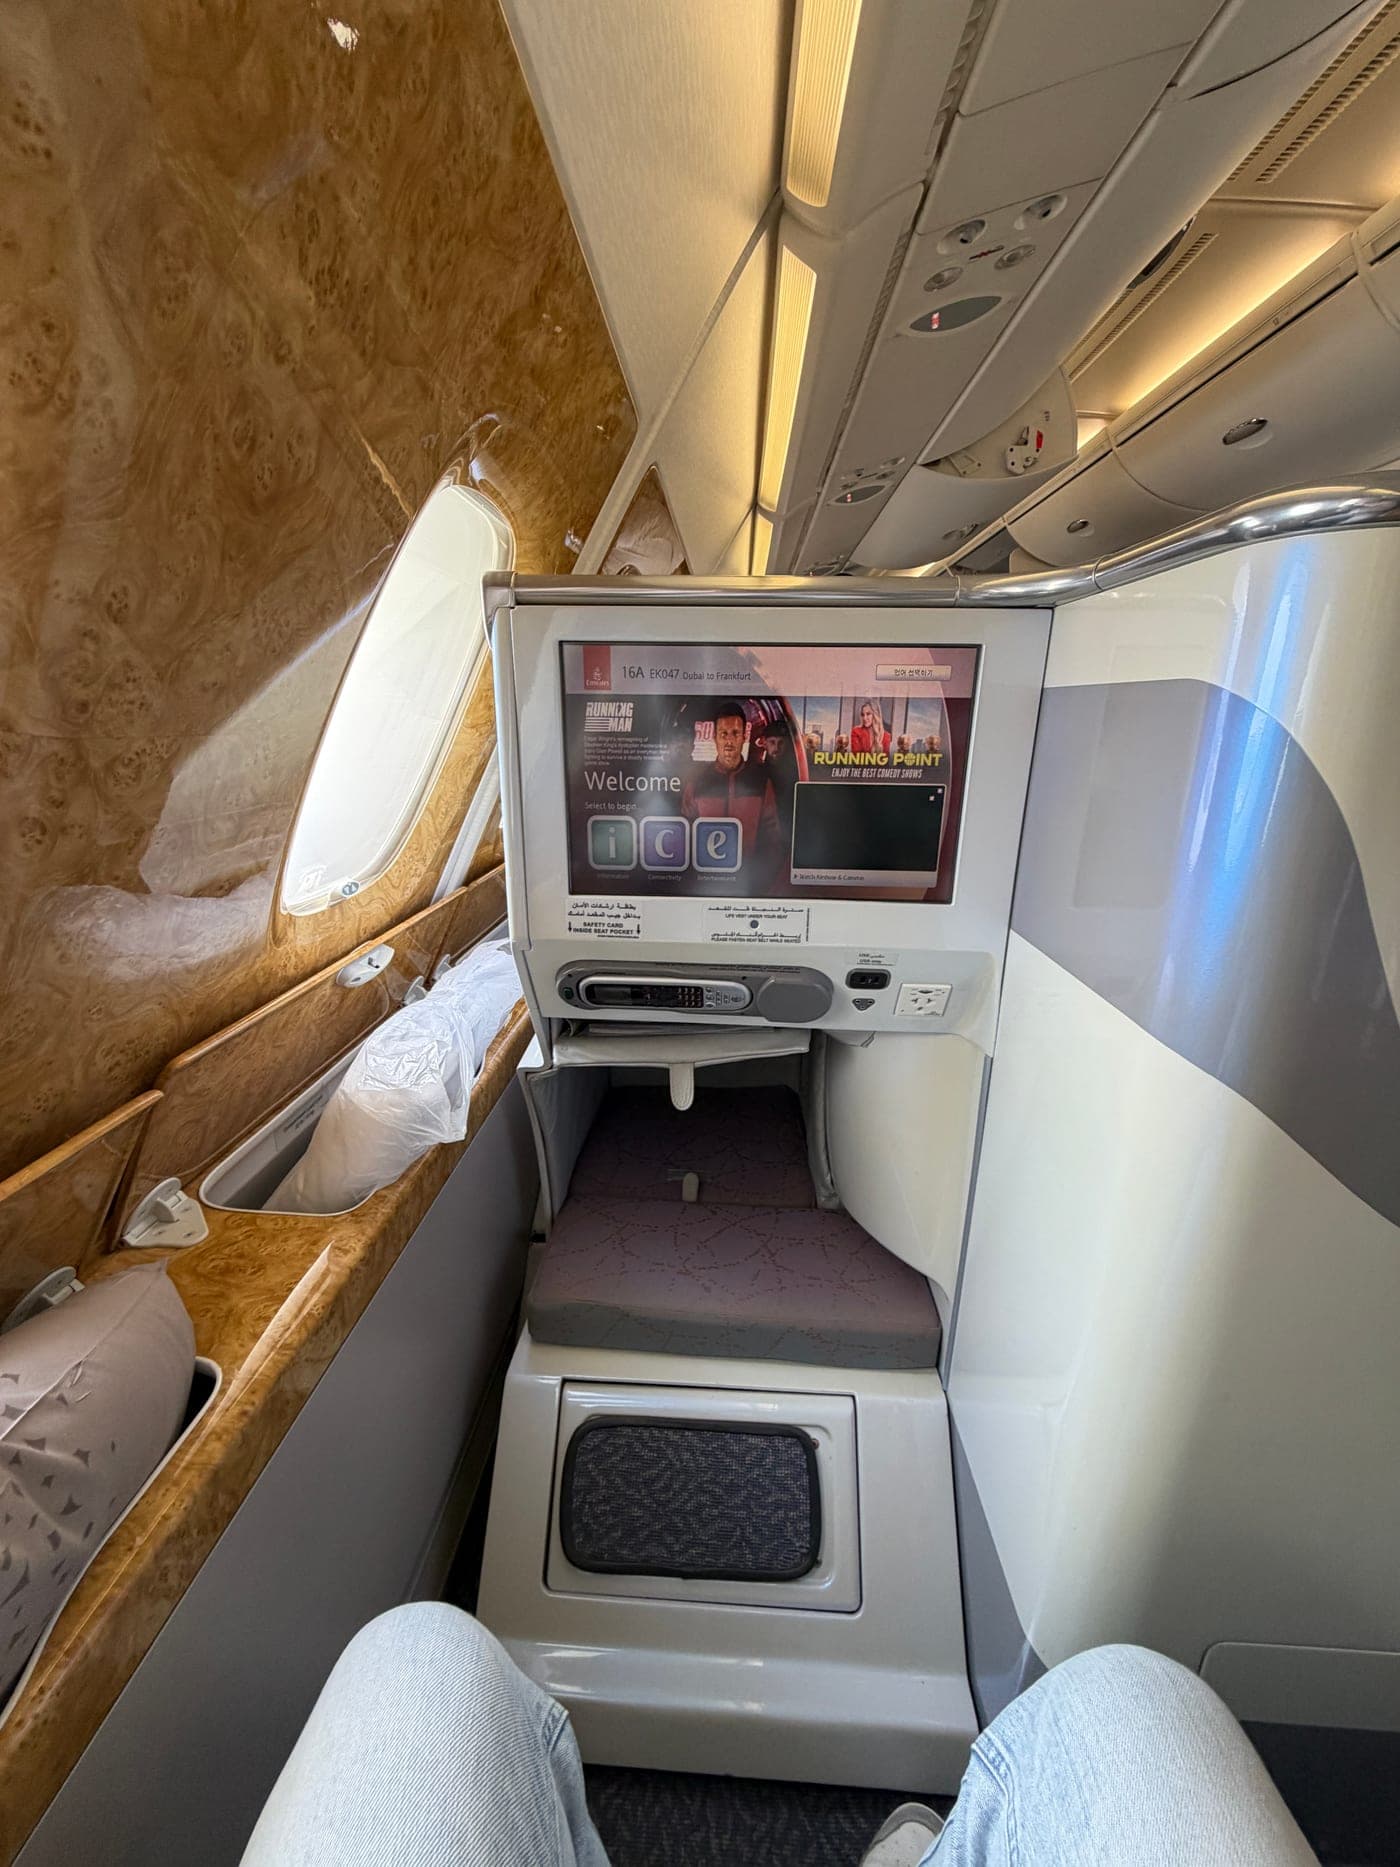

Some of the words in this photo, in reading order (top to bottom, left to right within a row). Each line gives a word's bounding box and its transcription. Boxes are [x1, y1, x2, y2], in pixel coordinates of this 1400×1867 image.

[622, 665, 644, 679] 16A
[650, 668, 680, 680] EK047
[683, 671, 704, 680] Dubai
[707, 672, 714, 680] to
[716, 670, 751, 681] Frankfurt
[608, 717, 633, 732] MAN
[814, 752, 889, 765] RUNNING
[893, 753, 943, 767] POINT
[831, 767, 850, 777] ENJOY
[851, 767, 861, 777] THE
[862, 768, 876, 778] BEST
[877, 768, 900, 778] COMEDY
[901, 769, 922, 778] SHOWS
[584, 770, 681, 791] Welcome
[584, 801, 606, 810] Select
[607, 801, 616, 810] to
